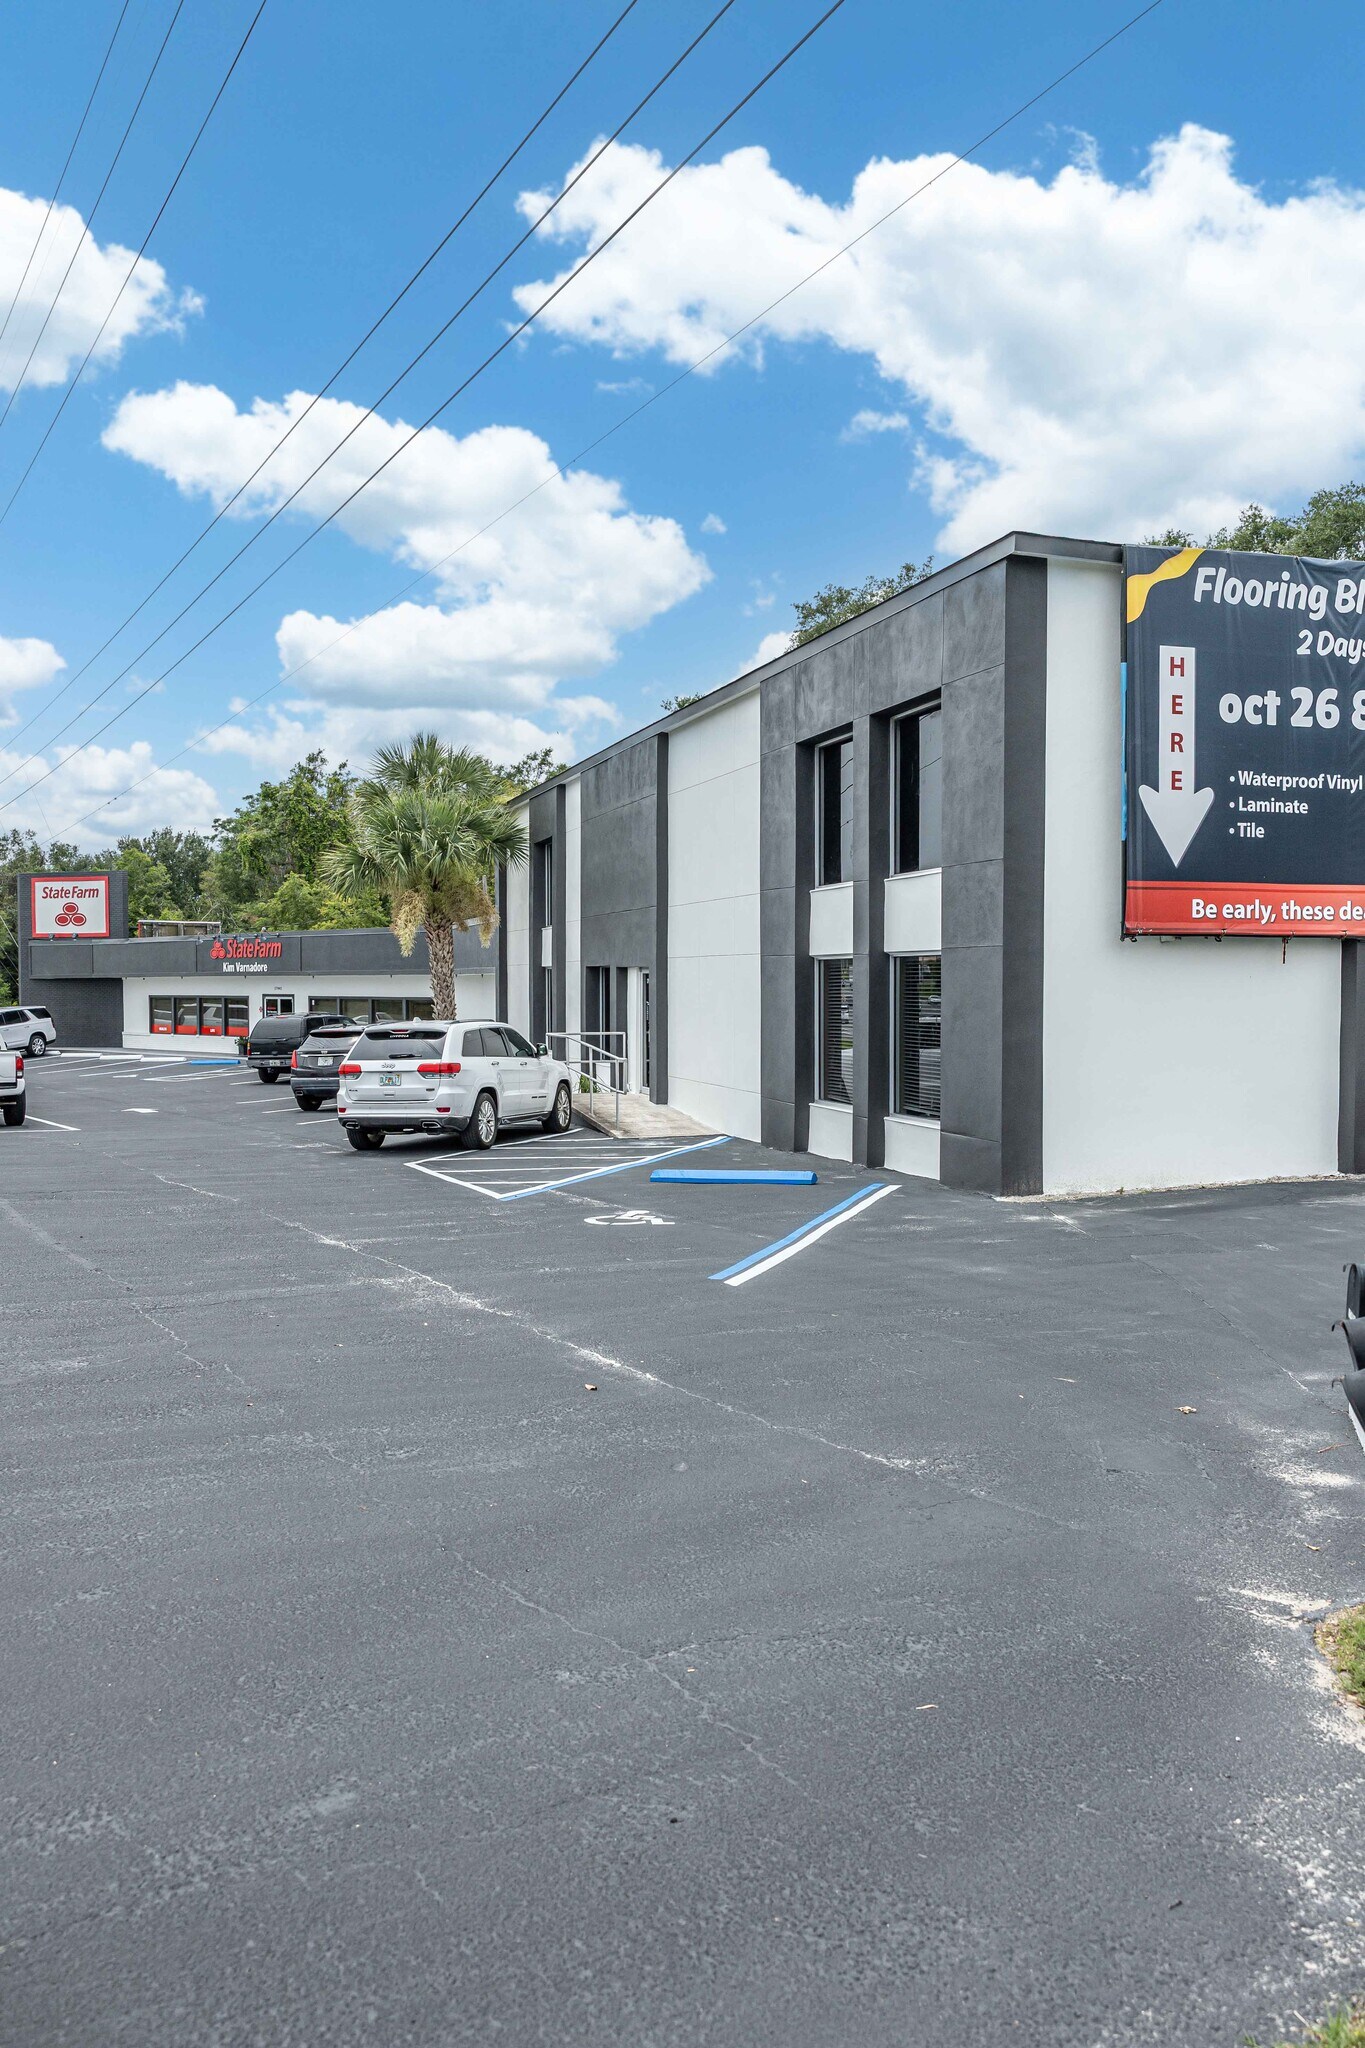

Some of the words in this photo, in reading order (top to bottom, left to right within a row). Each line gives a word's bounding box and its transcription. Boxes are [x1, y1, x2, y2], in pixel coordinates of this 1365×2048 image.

[1193, 566, 1329, 621] Flooring
[1296, 628, 1314, 655] 2
[1316, 630, 1365, 665] Day
[1218, 690, 1281, 726] oct
[1290, 686, 1341, 729] 26
[1237, 770, 1325, 791] Waterproof
[1326, 774, 1363, 794] Vinyl
[1238, 796, 1309, 815] Laminate
[1237, 822, 1265, 838] Tile
[1191, 898, 1218, 919] Be
[1222, 899, 1277, 925] early,
[1281, 900, 1335, 921] these
[1338, 900, 1365, 921] de
[222, 961, 235, 973] Kim
[235, 961, 268, 973] Varnadore
